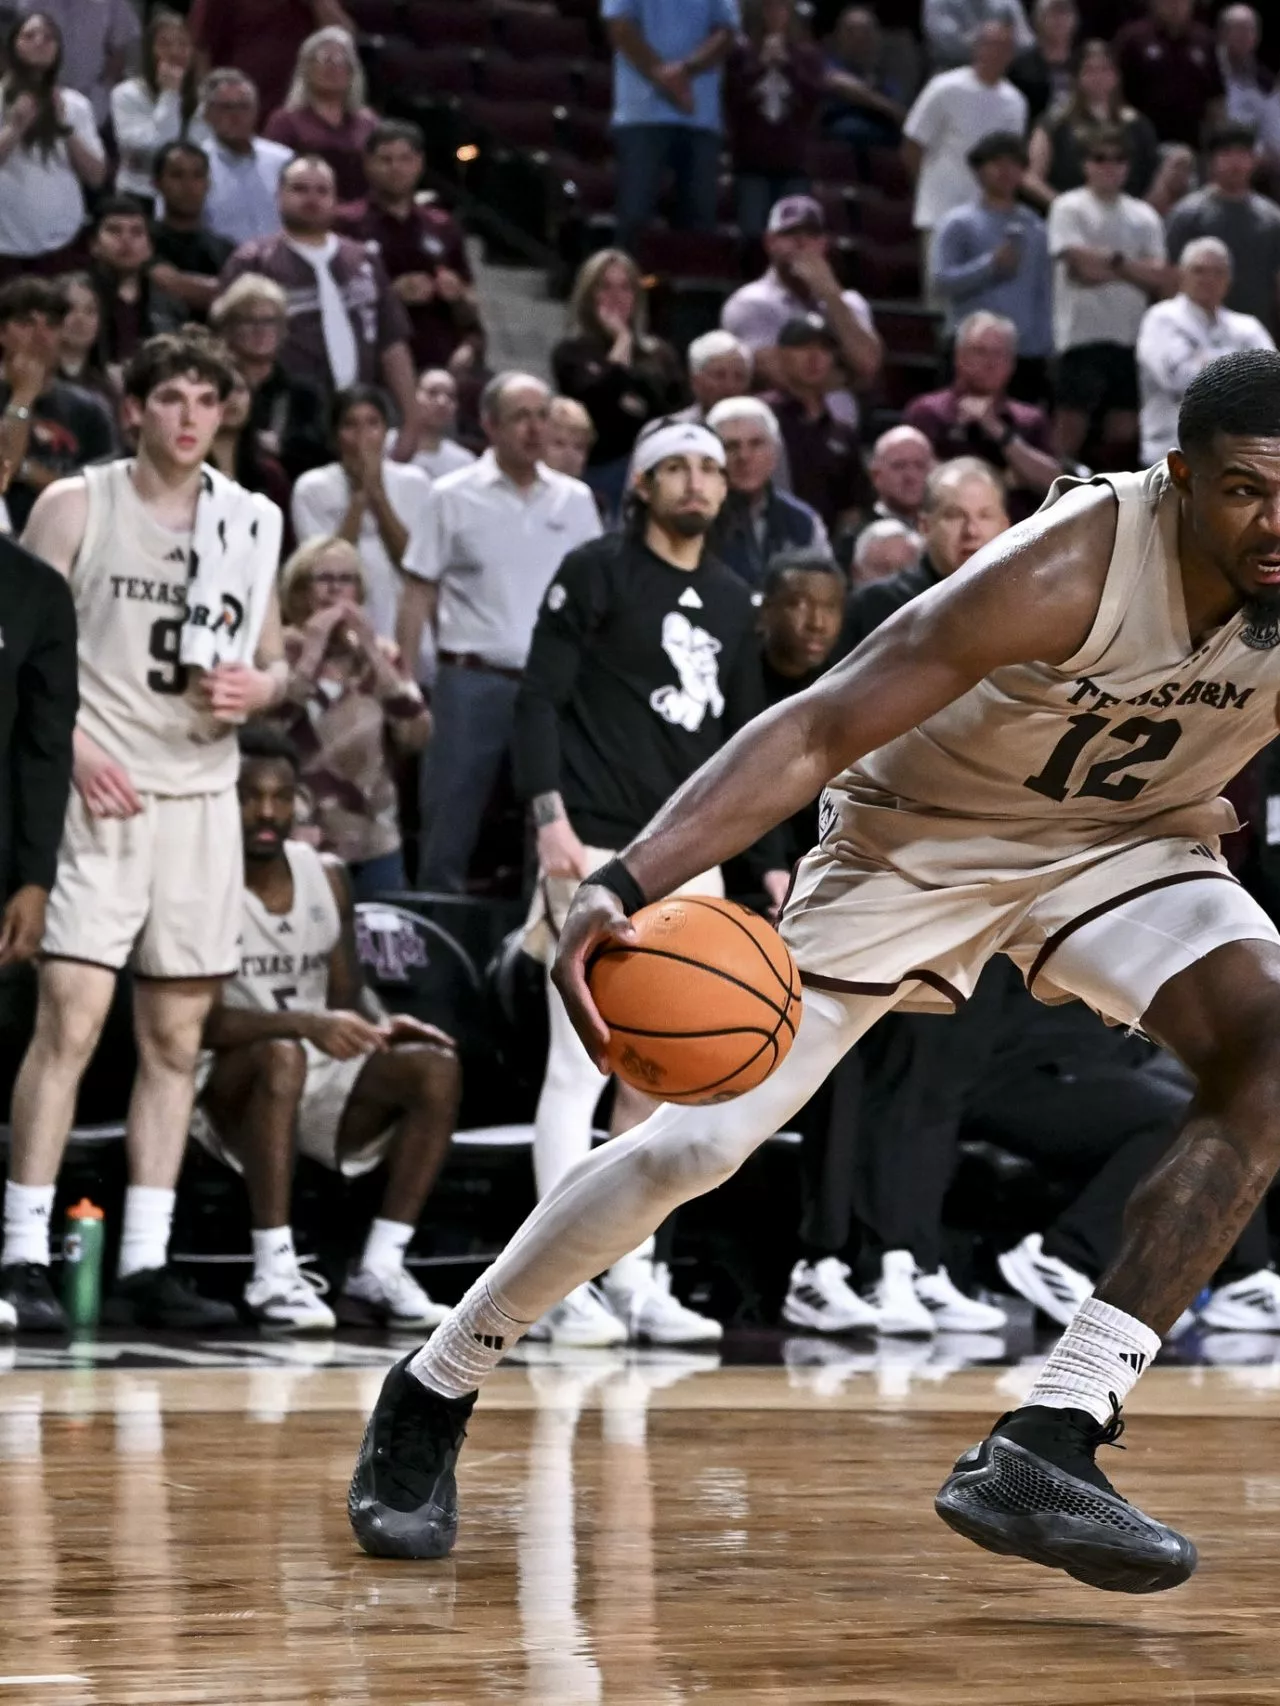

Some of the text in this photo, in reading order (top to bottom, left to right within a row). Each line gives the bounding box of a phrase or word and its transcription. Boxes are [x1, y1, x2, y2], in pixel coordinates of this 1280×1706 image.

[111, 576, 186, 604] TEXAS
[148, 618, 189, 694] 9
[1174, 679, 1257, 711] A&M
[1022, 712, 1183, 803] 12
